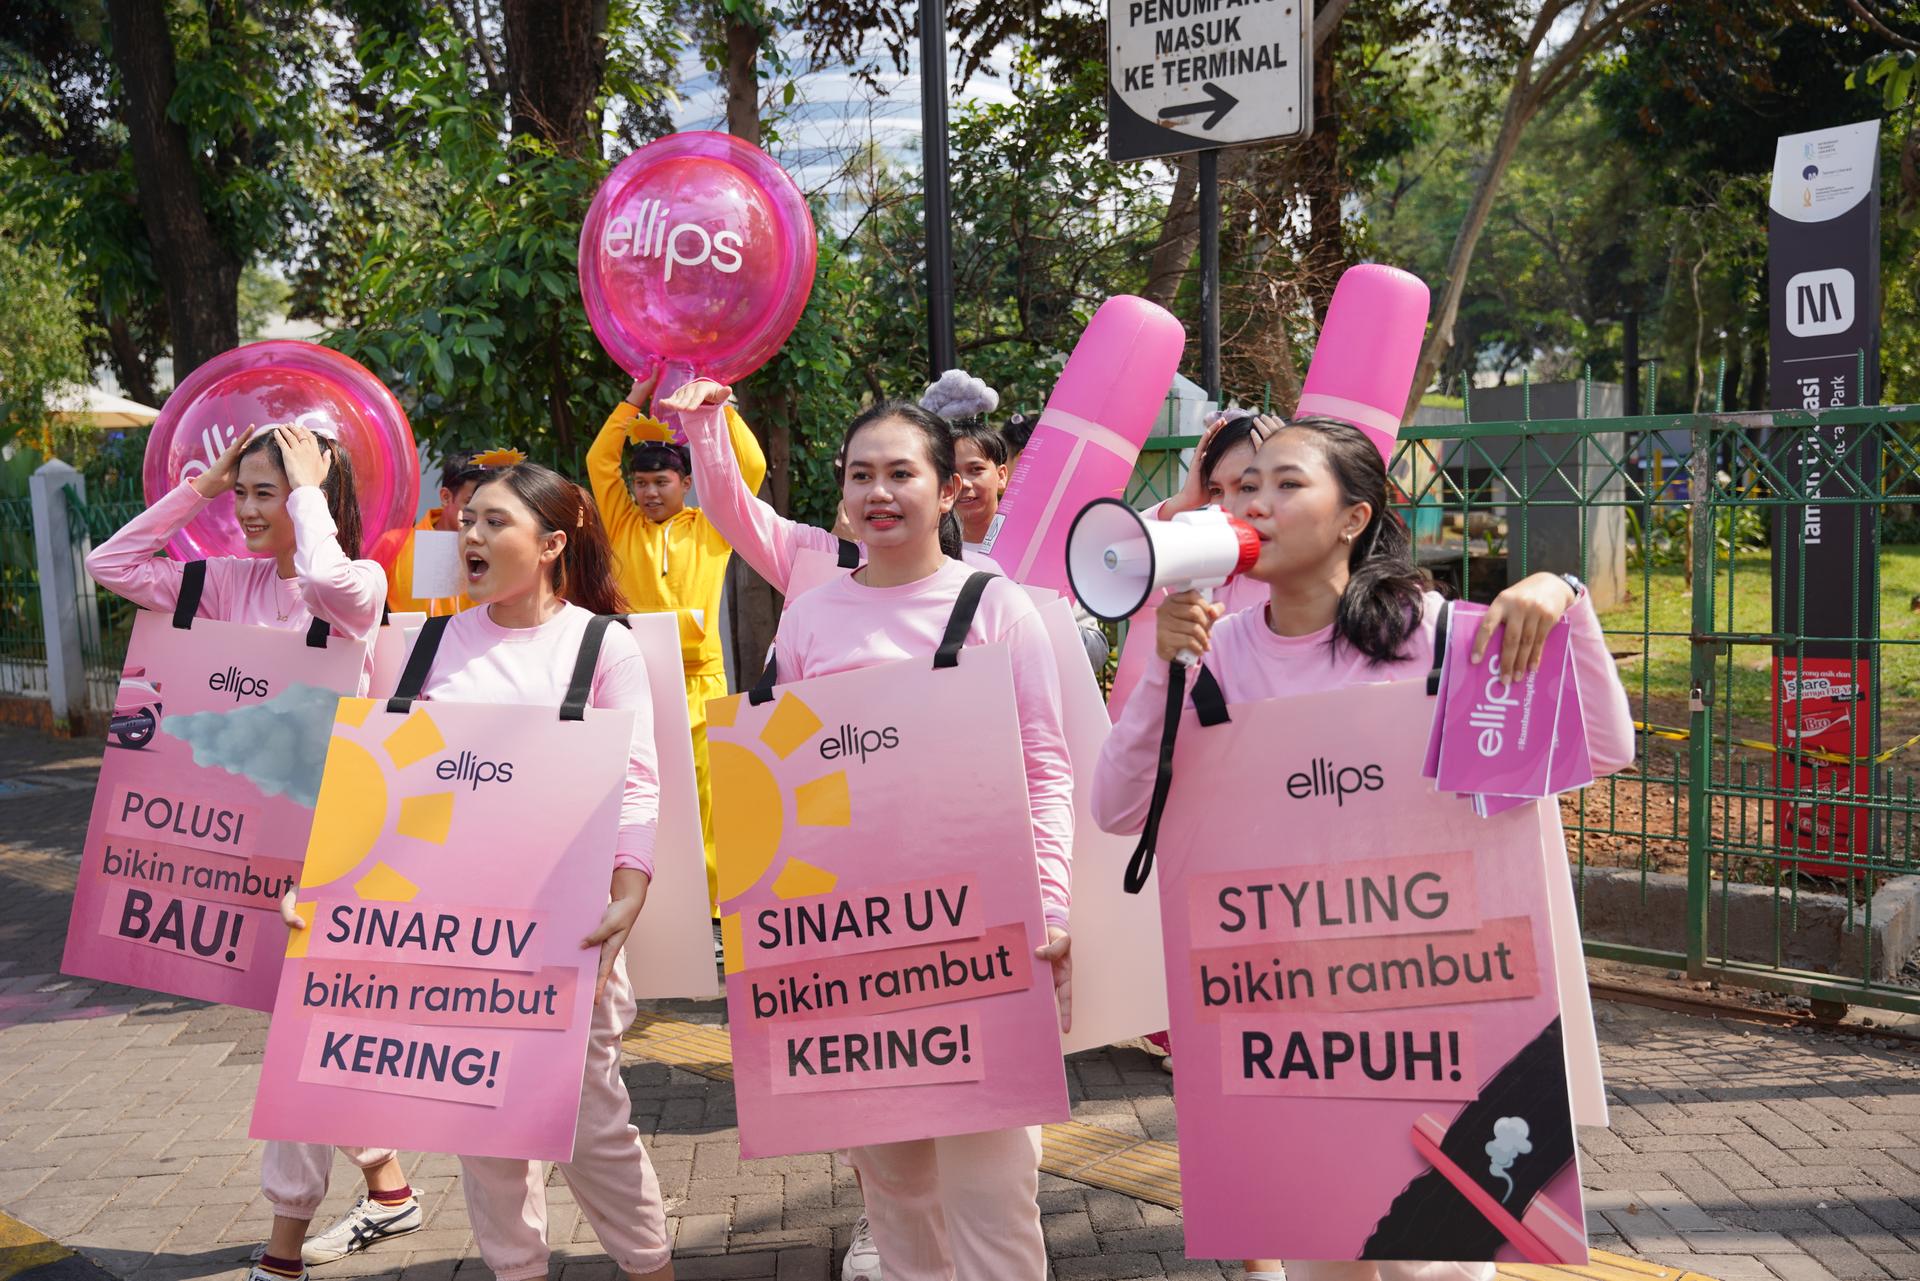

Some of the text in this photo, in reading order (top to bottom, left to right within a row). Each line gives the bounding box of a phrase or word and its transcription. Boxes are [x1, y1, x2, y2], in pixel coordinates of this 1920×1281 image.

[1156, 16, 1241, 55] MASUK
[1124, 43, 1287, 92] KE TERMINAL
[605, 198, 743, 282] ellips
[1830, 375, 1845, 407] Park
[209, 666, 269, 702] ellips
[820, 723, 900, 764] ellips
[1806, 718, 1830, 731] Bro
[436, 750, 514, 791] ellips
[1287, 757, 1384, 807] ellips
[121, 791, 244, 845] POLUSI
[102, 846, 294, 899] bikin rambut
[118, 888, 244, 963] BAU!
[757, 885, 968, 950] SINAR UV
[1218, 872, 1449, 933] STYLING
[326, 905, 537, 958] SINAR UV
[303, 971, 557, 1015] bikin rambut
[751, 945, 1013, 1019] bikin rambut
[1201, 942, 1514, 1006] bikin rambut
[319, 1031, 501, 1089] KERING!
[786, 1024, 972, 1077] KERING!
[1241, 1031, 1463, 1082] RAPUH!
